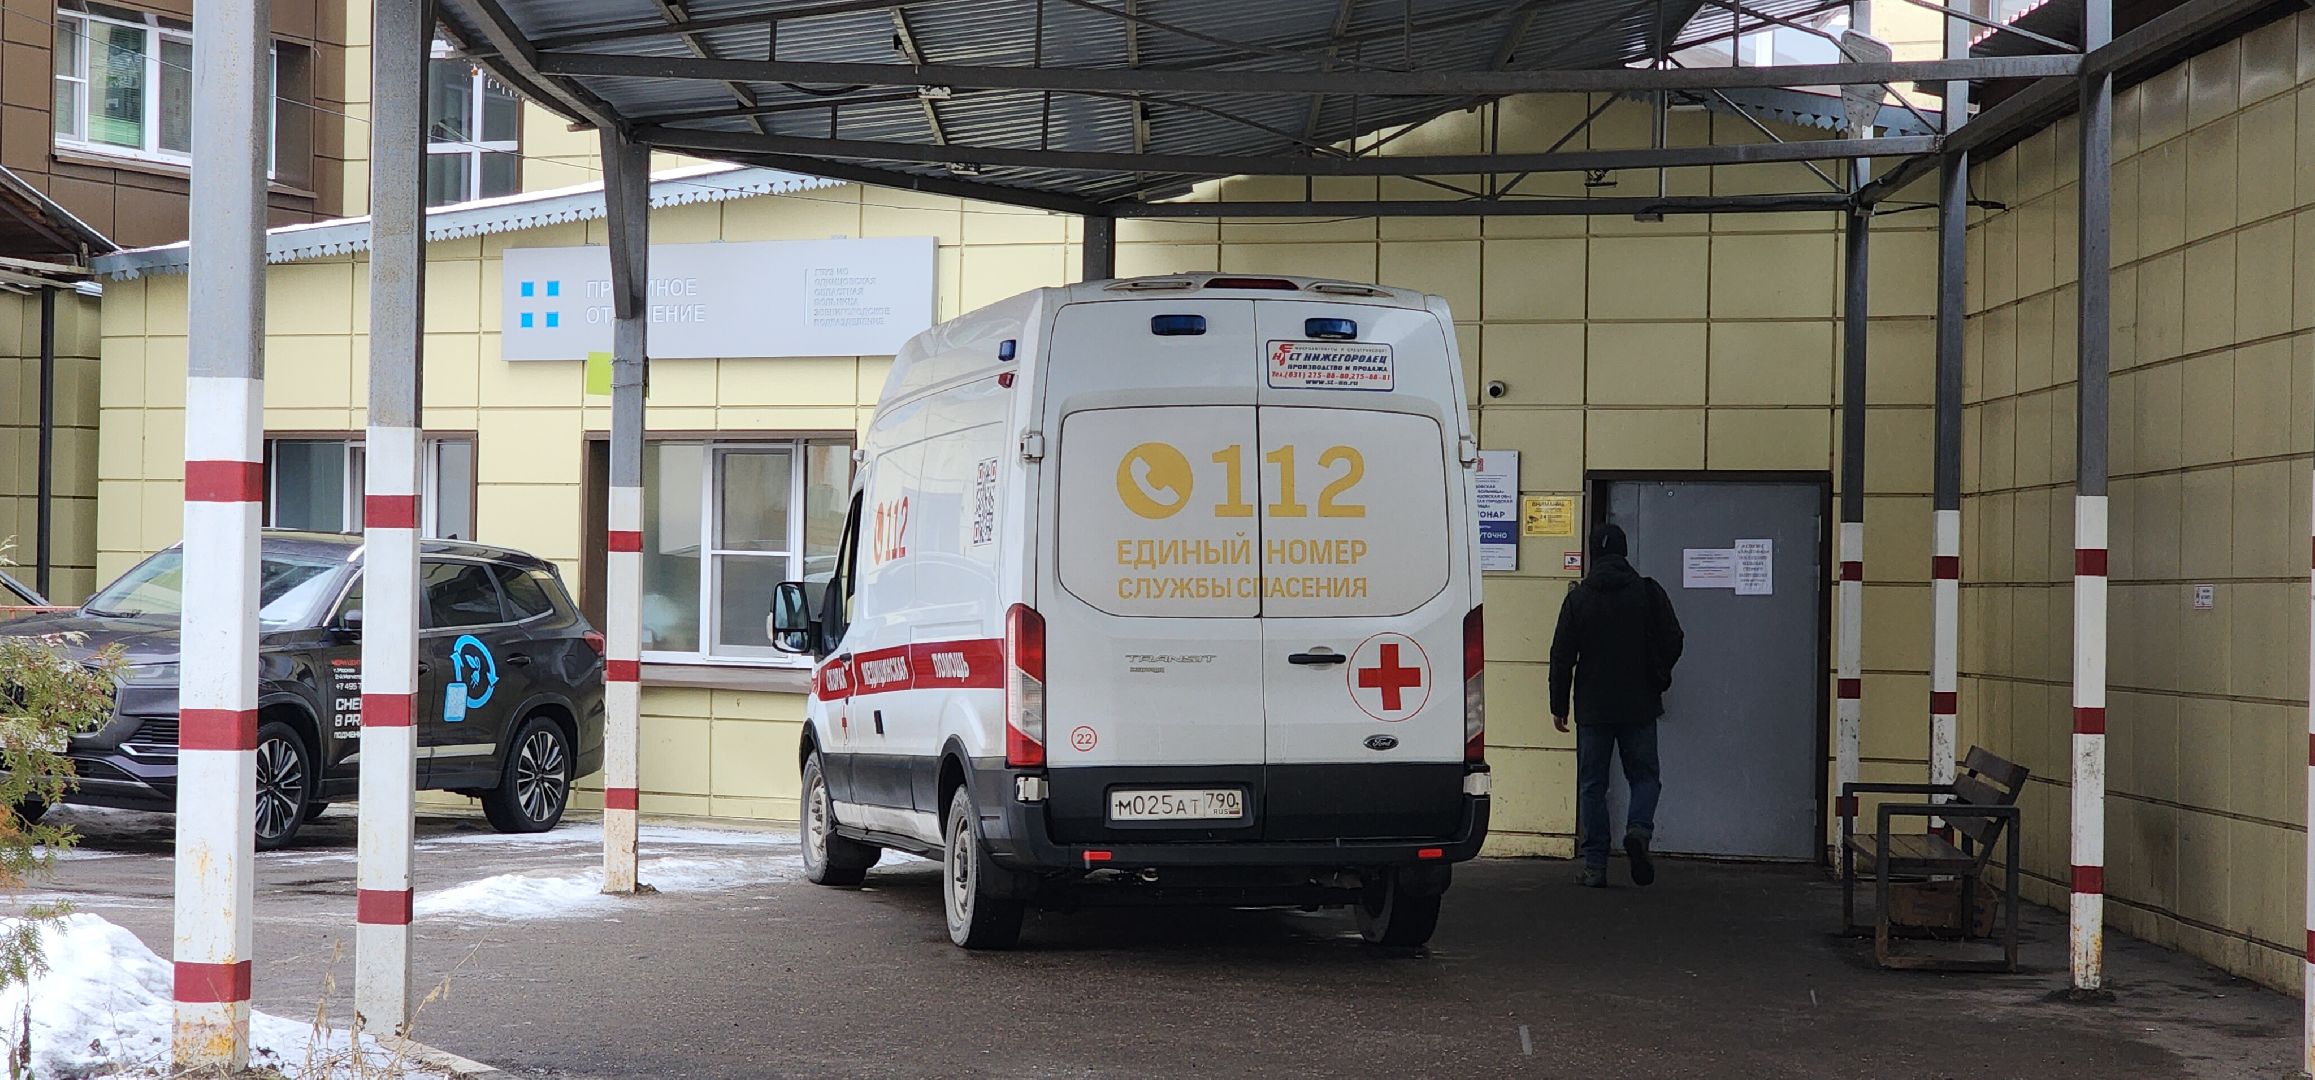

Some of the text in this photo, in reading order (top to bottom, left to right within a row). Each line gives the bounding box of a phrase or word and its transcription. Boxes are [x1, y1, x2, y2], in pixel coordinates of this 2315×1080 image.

[1303, 353, 1387, 364] НИЖЕГОРОДЕЦ
[1212, 444, 1365, 517] 112
[1117, 532, 1368, 569] ЕДИНЫЙ НОМЕР
[1118, 577, 1368, 599] СЛУЖБЫ СПАСЕНИЯ
[931, 651, 970, 683] ПОМОЩЬ
[335, 714, 343, 726] 8
[1076, 733, 1092, 745] 22
